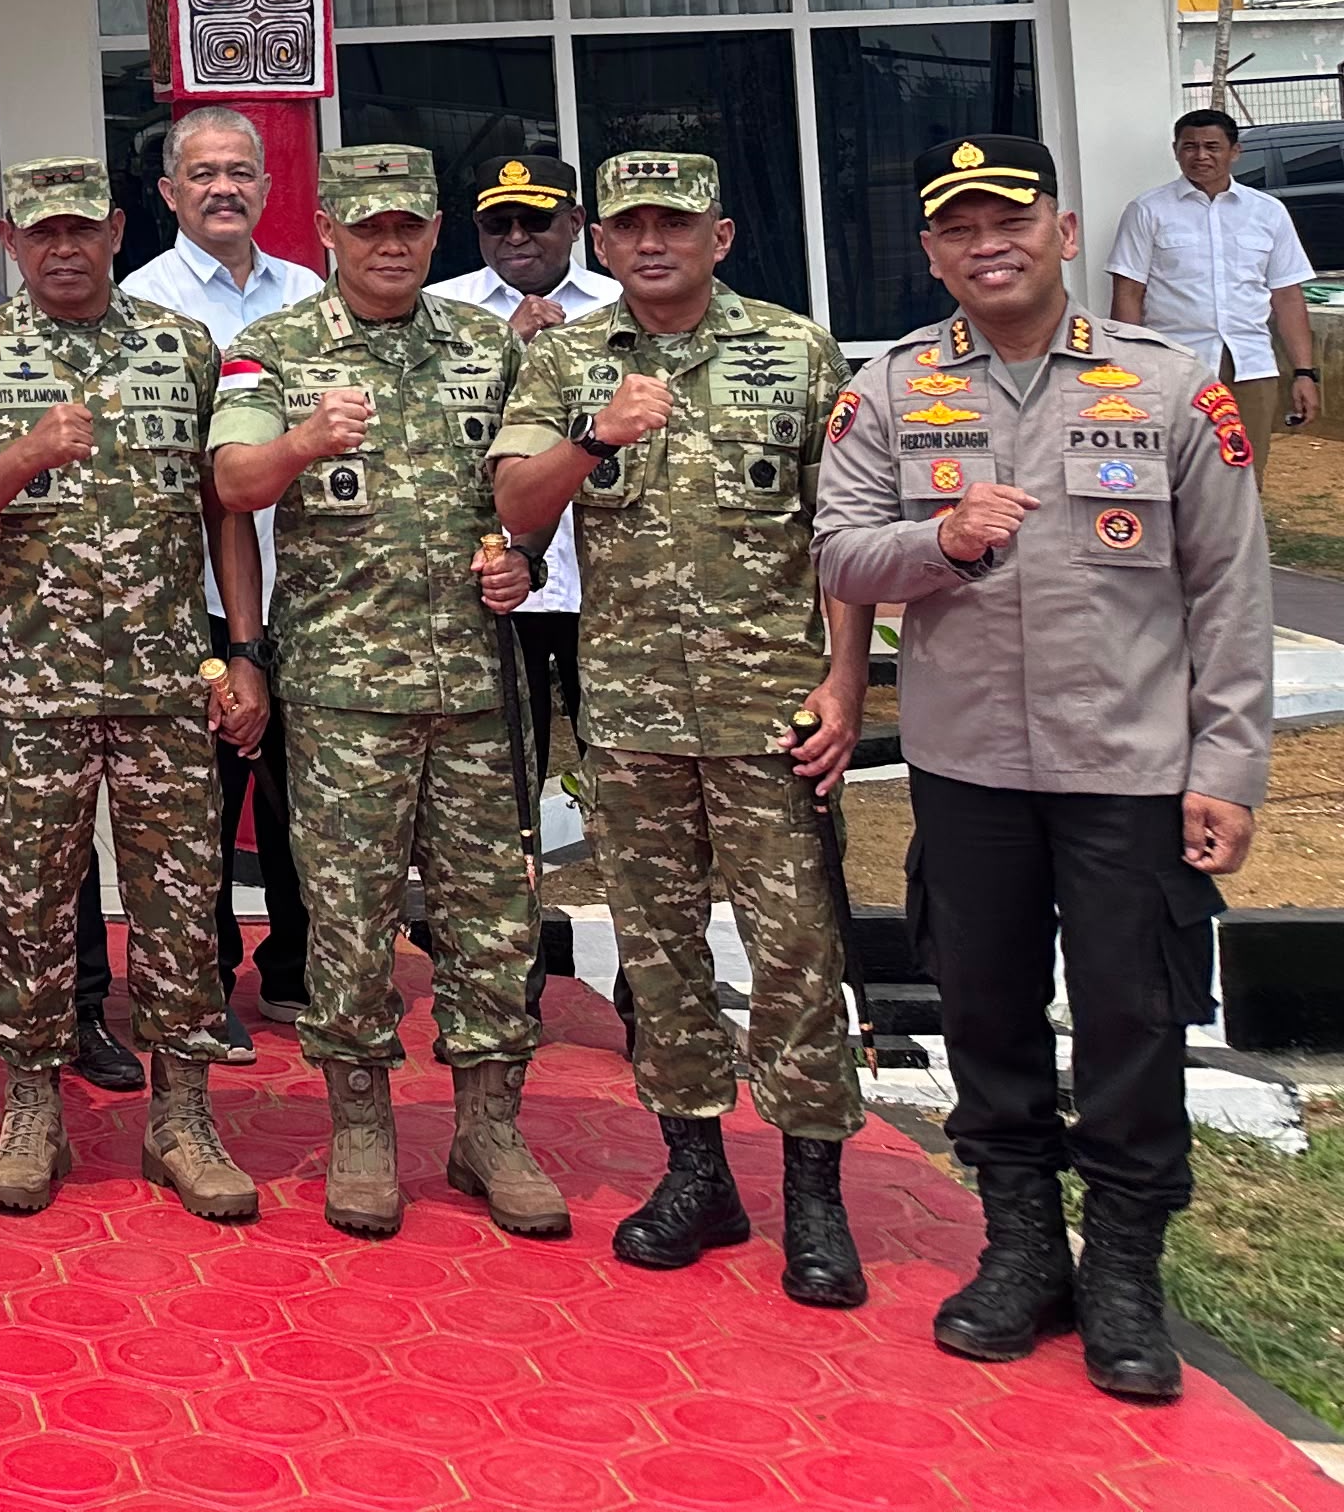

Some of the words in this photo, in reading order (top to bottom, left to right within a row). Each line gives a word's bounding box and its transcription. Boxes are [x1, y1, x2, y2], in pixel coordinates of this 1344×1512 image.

[17, 389, 69, 403] PELAMONIA
[131, 387, 160, 401] TNI
[170, 387, 189, 402] AD
[444, 386, 479, 400] TNI
[485, 386, 500, 400] AD
[729, 390, 759, 403] TNI
[772, 390, 794, 405] AU
[1070, 430, 1160, 449] POLRI
